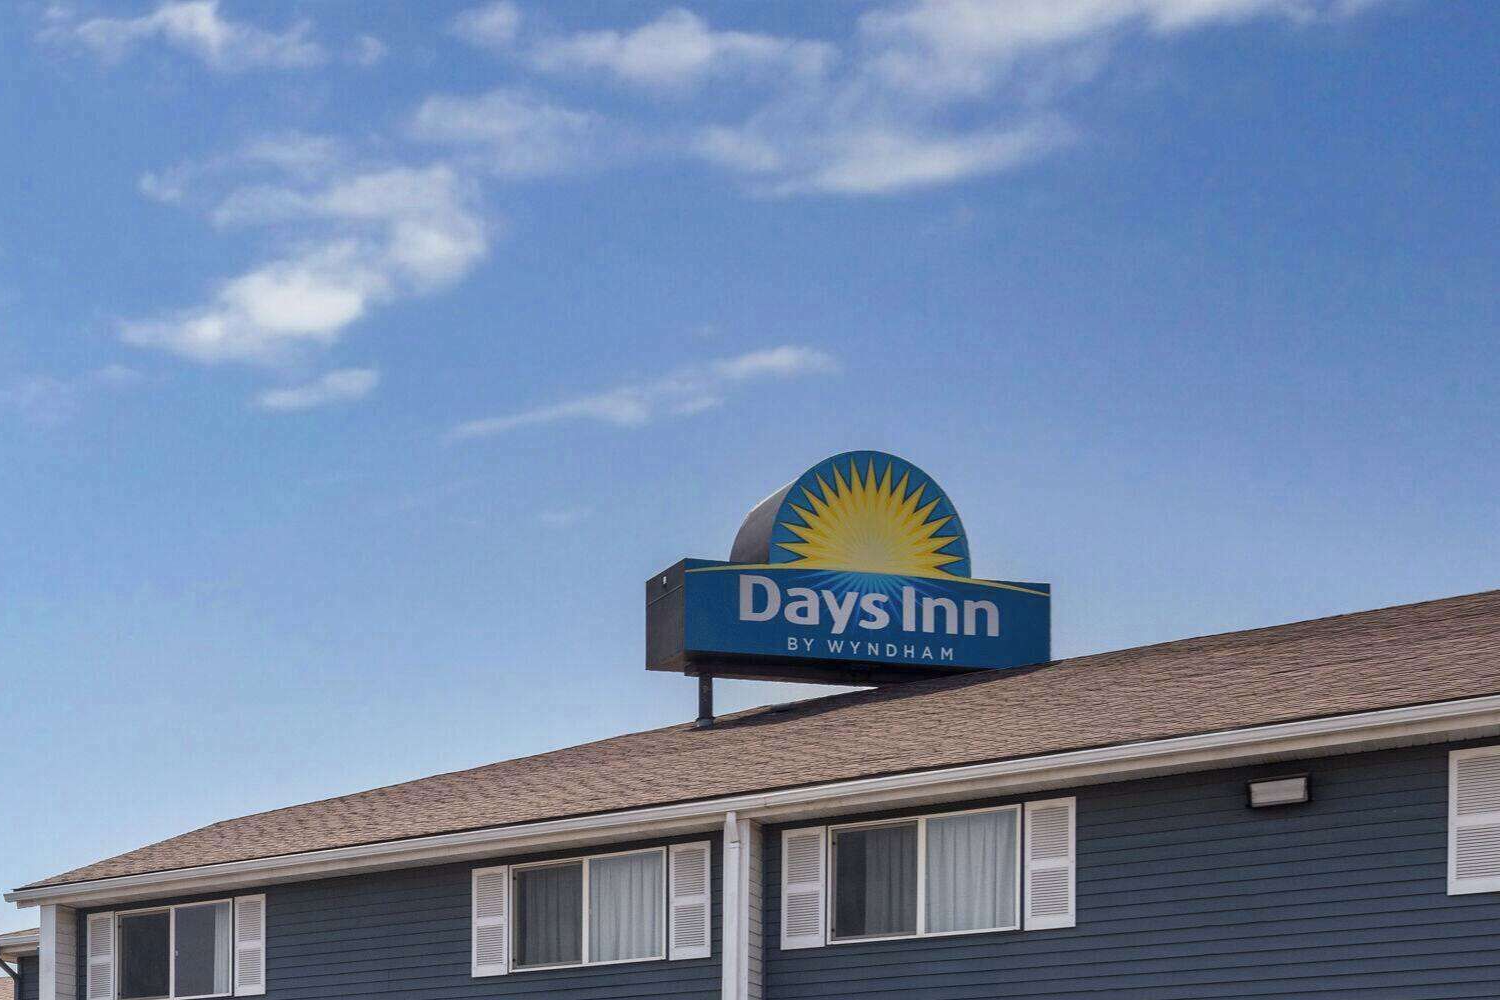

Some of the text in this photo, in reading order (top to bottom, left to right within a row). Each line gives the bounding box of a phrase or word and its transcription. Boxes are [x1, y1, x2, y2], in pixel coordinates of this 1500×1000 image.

[739, 574, 999, 637] Days Inn
[788, 637, 954, 661] BY WYNDHAM
